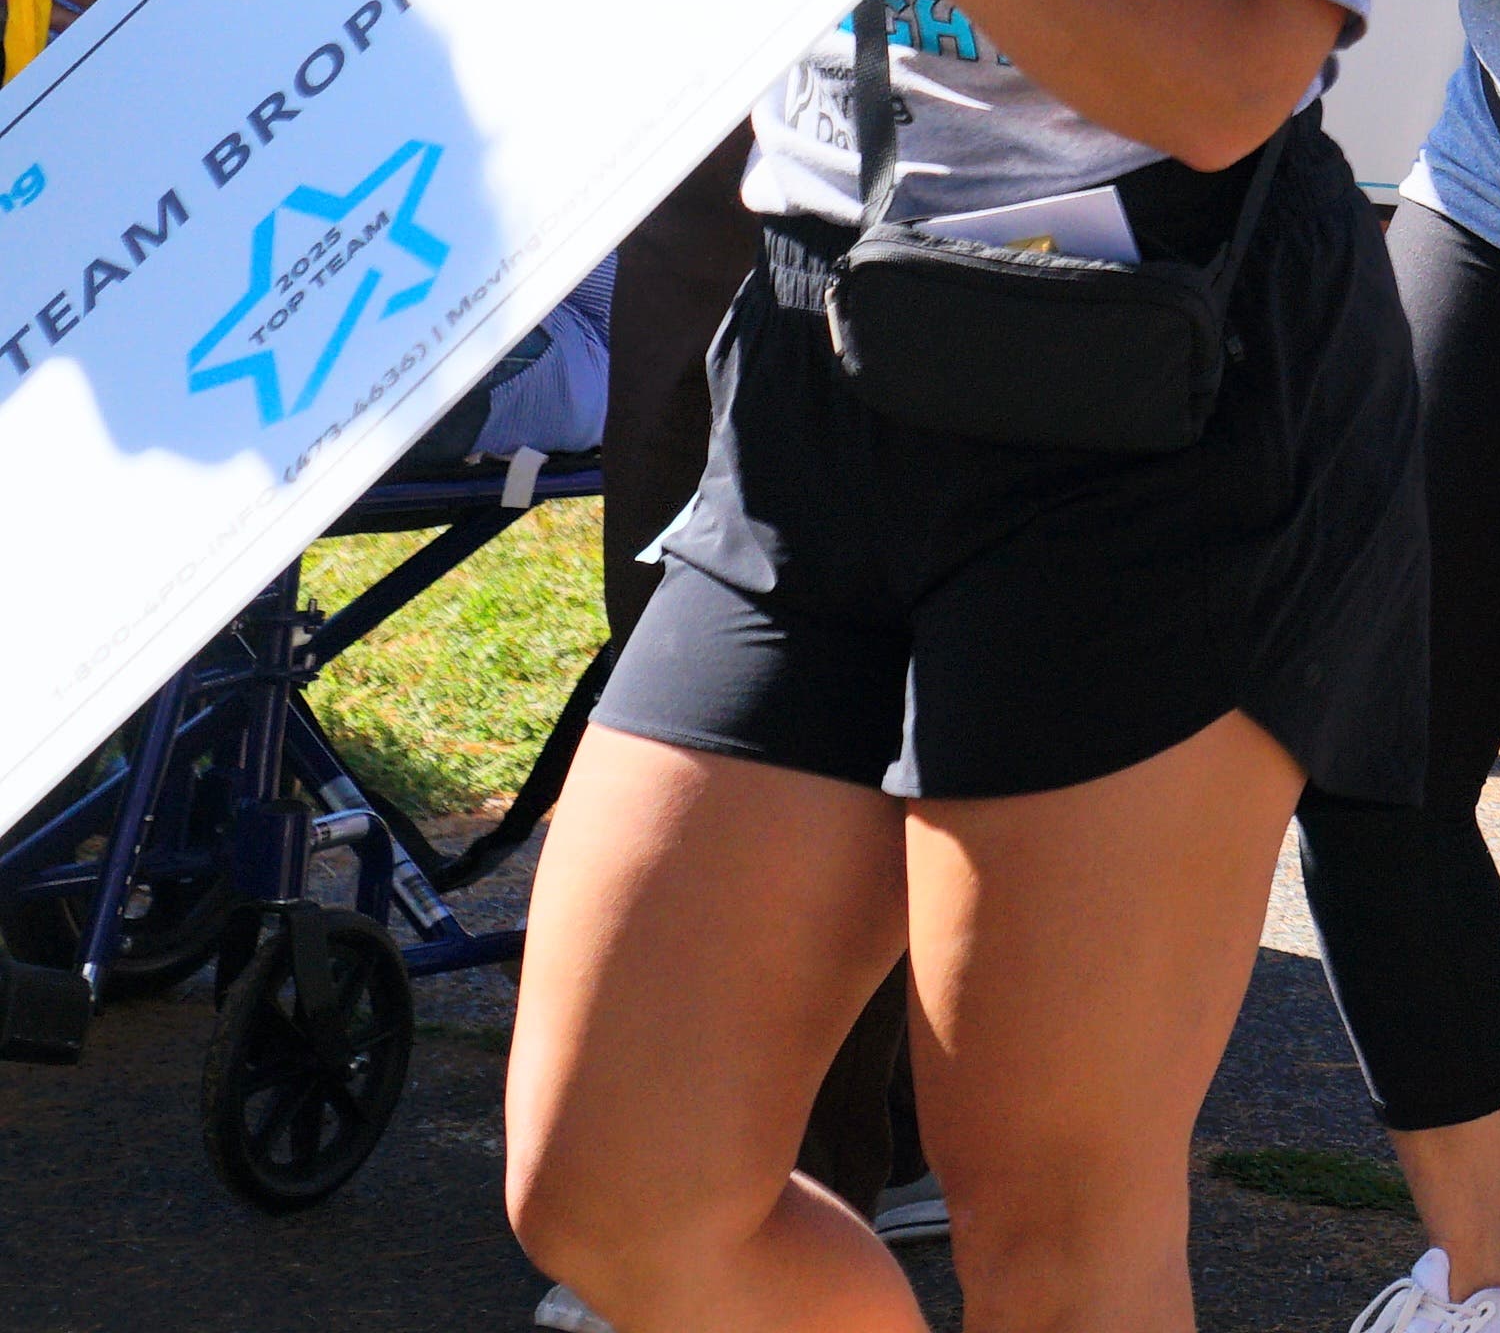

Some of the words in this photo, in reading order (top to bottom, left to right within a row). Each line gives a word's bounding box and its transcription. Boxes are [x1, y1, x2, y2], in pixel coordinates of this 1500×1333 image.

[0, 187, 190, 376] TEAM
[249, 290, 305, 346] TOP
[308, 210, 391, 289] TEAM
[274, 226, 343, 296] 2025
